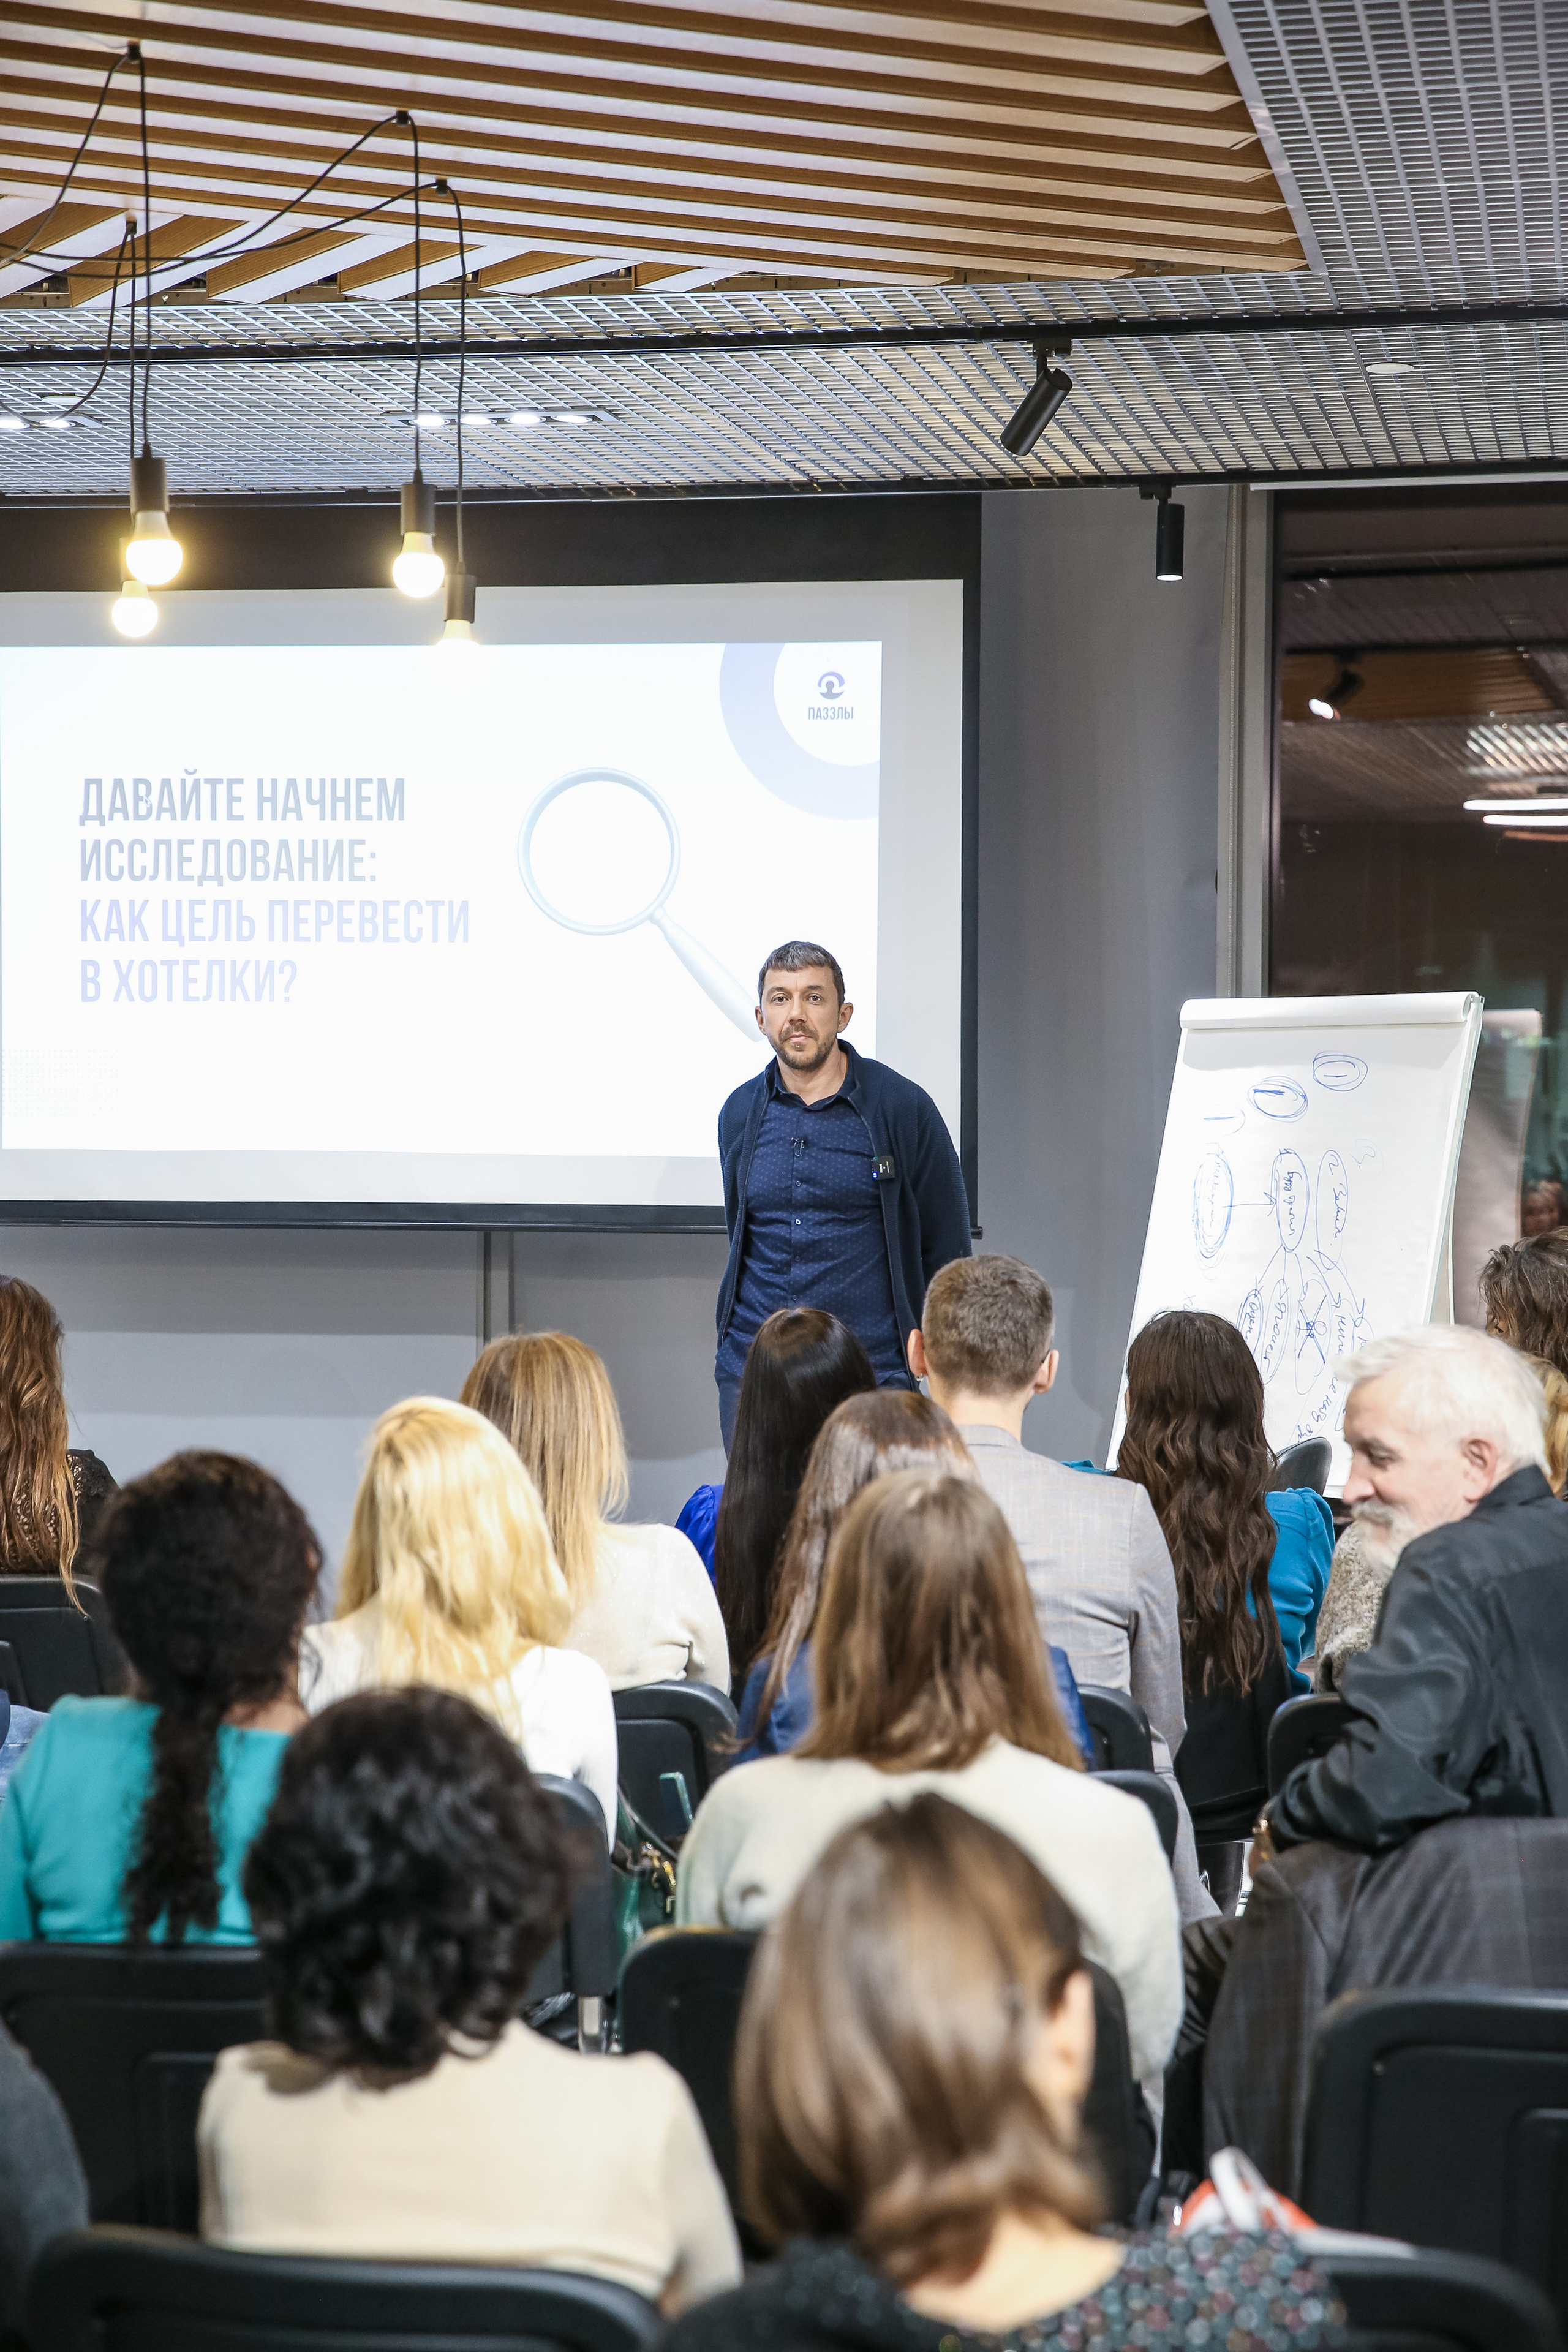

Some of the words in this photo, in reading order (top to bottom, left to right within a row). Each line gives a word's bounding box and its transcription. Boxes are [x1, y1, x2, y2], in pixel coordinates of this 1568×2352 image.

[808, 707, 853, 720] ПАЗЗЛЫ
[79, 769, 244, 826] ДАВАЙТЕ
[257, 778, 405, 821] НАЧНЕМ
[80, 839, 376, 887] ИССЛЕДОВАНИЕ:
[81, 899, 150, 942] КАК
[162, 899, 255, 947] ЦЕЛЬ
[268, 900, 469, 943] ПЕРЕВЕСТИ
[81, 960, 101, 1003] В
[113, 960, 297, 1003] ХОТЕЛКИ?
